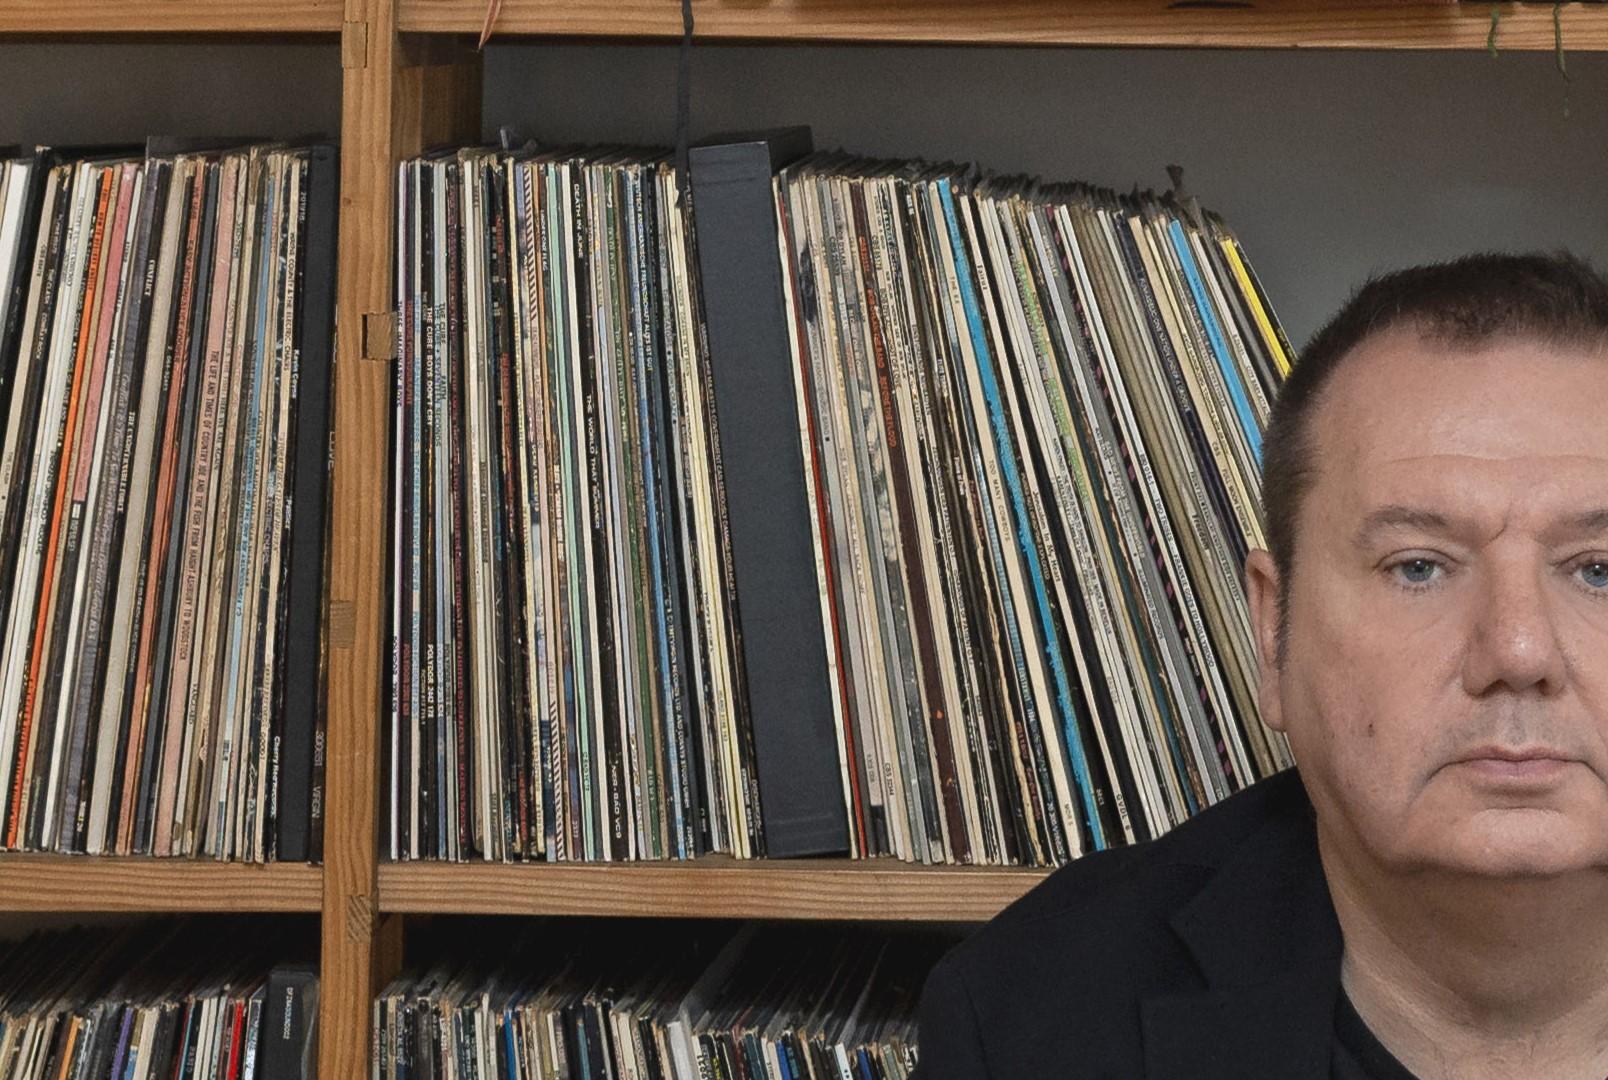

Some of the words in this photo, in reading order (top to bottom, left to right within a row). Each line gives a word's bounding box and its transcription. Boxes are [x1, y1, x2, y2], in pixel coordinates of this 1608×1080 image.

[573, 183, 581, 217] DEATH
[575, 231, 583, 258] JUNE
[46, 268, 54, 281] THE
[143, 258, 155, 296] CONFLICT
[286, 258, 295, 287] COUNTY
[948, 276, 957, 291] THE
[976, 264, 988, 290] Fairuz
[42, 281, 52, 304] CLASH
[285, 295, 293, 309] THE
[283, 311, 292, 342] ELECTRIC
[208, 350, 219, 363] THE
[282, 344, 290, 371] CHAIRS
[206, 364, 218, 380] LIFE
[205, 381, 216, 395] AND
[202, 397, 214, 418] TIMES
[585, 394, 593, 413] THE
[201, 419, 212, 428] OF
[198, 430, 211, 462] COUNTRY
[586, 416, 596, 454] WORLD
[196, 463, 207, 477] JOE
[589, 456, 597, 483] THAT
[987, 459, 997, 475] TOO
[195, 478, 206, 493] AND
[991, 477, 1002, 500] MANY
[193, 494, 204, 508] THE
[591, 484, 600, 529] SUMMER
[1031, 489, 1048, 530] Jerusalem
[1153, 497, 1164, 514] TWO
[1220, 467, 1232, 485] FULL
[1226, 485, 1239, 505] MOON
[1233, 505, 1251, 538] ENSEMBLE
[191, 509, 202, 525] FISH
[997, 504, 1011, 541] COWBOYS
[189, 527, 200, 546] FROM
[1041, 532, 1050, 542] In
[1044, 543, 1054, 558] My
[1048, 559, 1061, 583] Heart
[1172, 552, 1189, 587] FRANKIE
[1183, 586, 1196, 608] GOES
[182, 608, 192, 617] TO
[1189, 608, 1200, 620] TO
[178, 619, 191, 660] WOODSTOCK
[1193, 619, 1215, 668] HOLLYWOOD
[311, 785, 323, 819] VIRGIN
